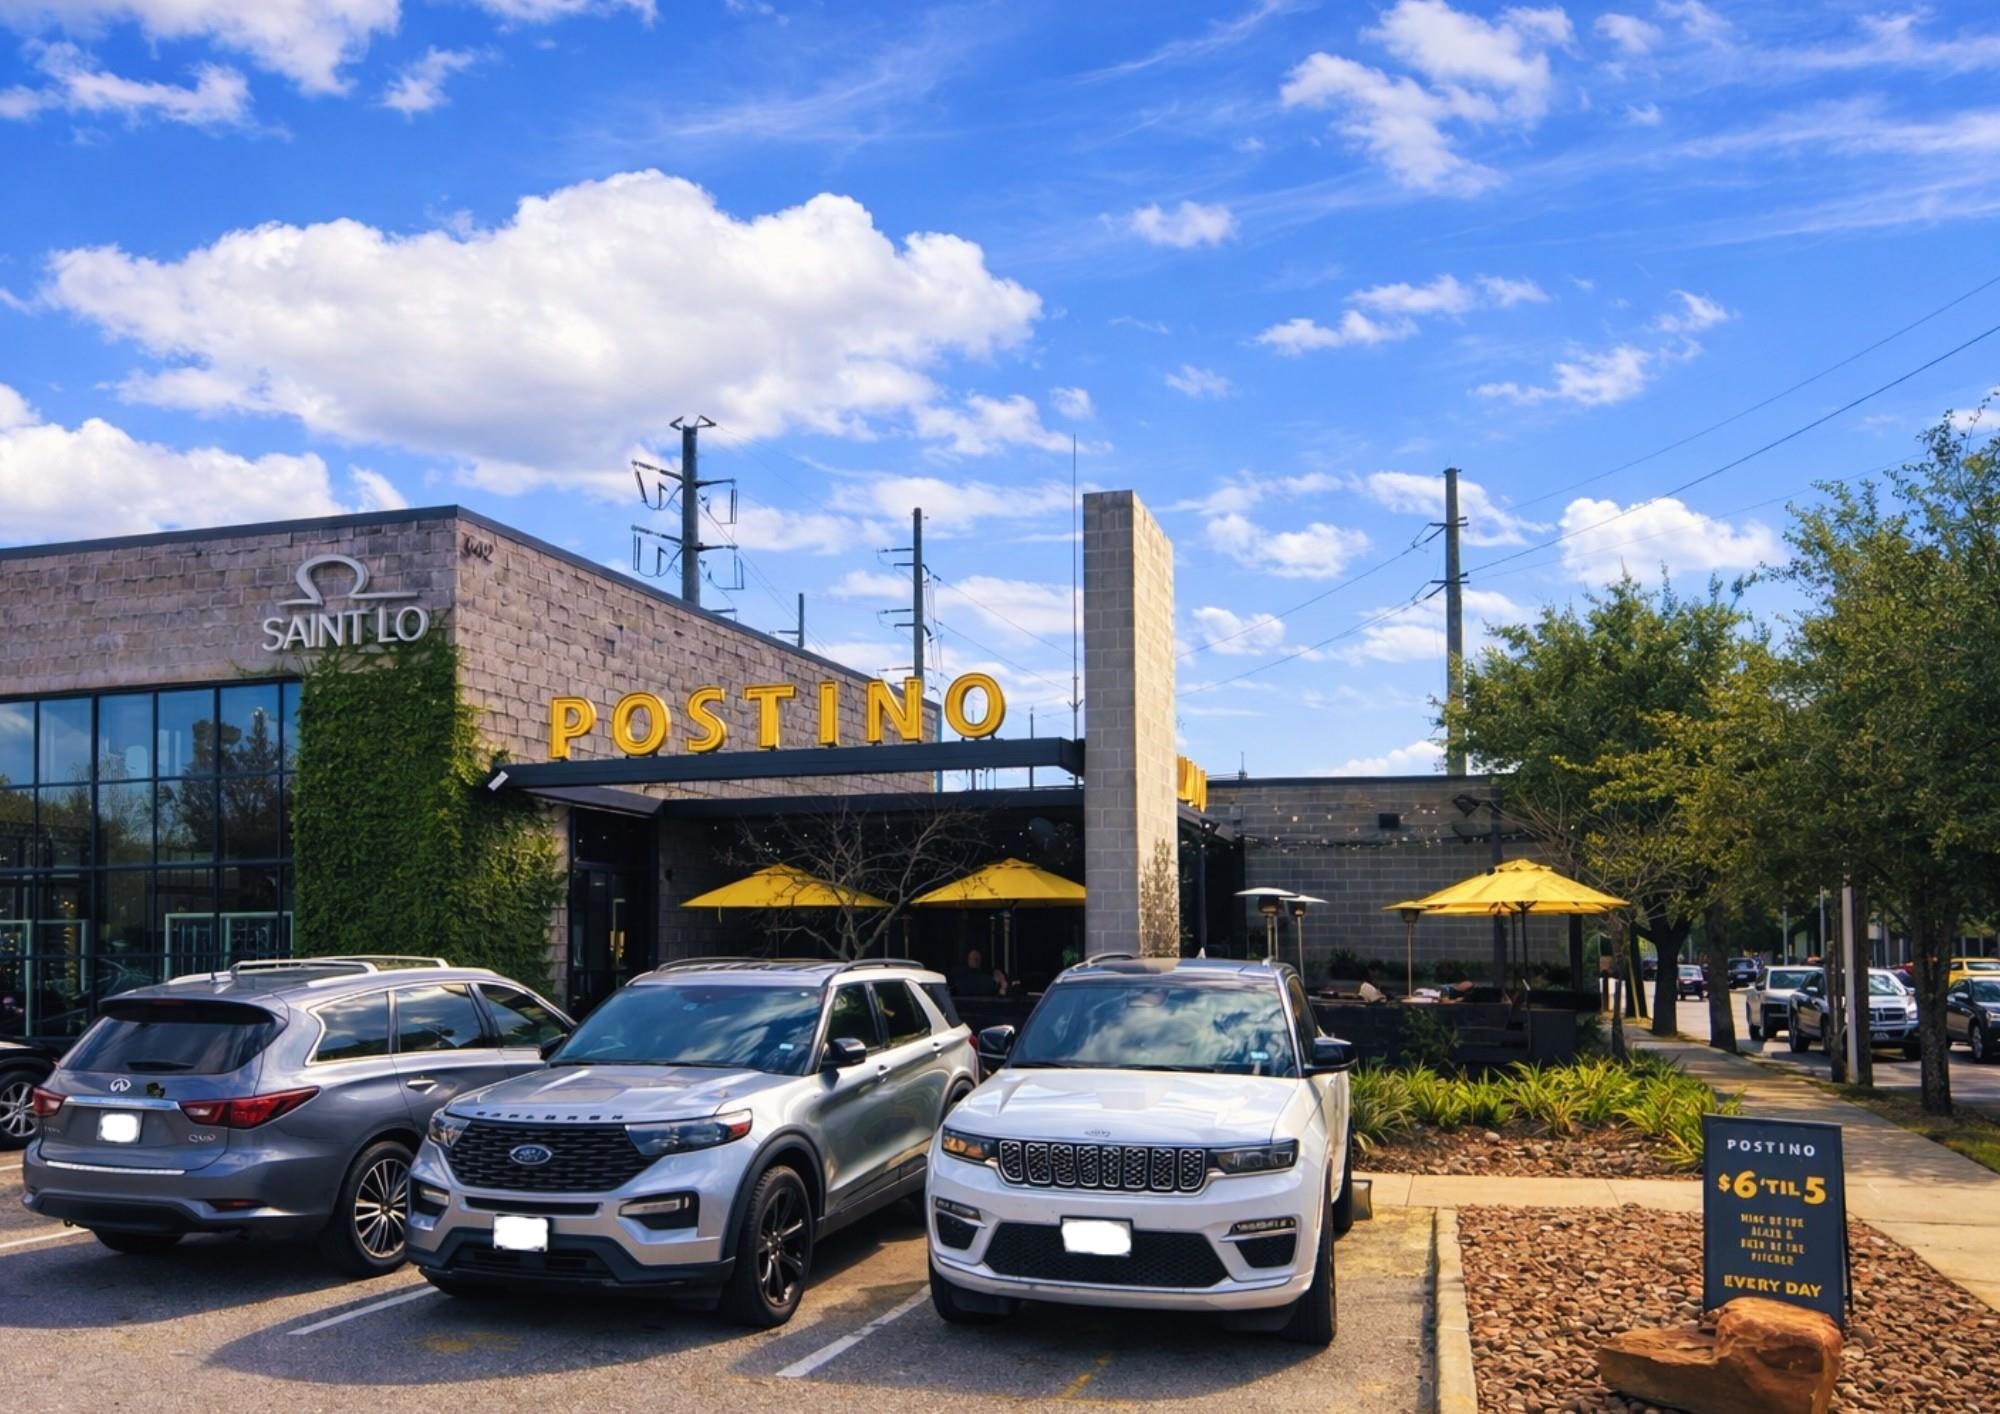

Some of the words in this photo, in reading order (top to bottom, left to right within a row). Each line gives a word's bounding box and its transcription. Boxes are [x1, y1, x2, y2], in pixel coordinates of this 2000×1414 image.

[262, 610, 371, 651] SAINT
[377, 605, 429, 643] LO
[549, 672, 1006, 761] POSTINO
[1727, 1139, 1815, 1157] POSTINO
[1718, 1170, 1757, 1198] $6
[1804, 1176, 1826, 1204] 5
[1723, 1274, 1780, 1292] EVERY
[1785, 1282, 1822, 1298] DAY
